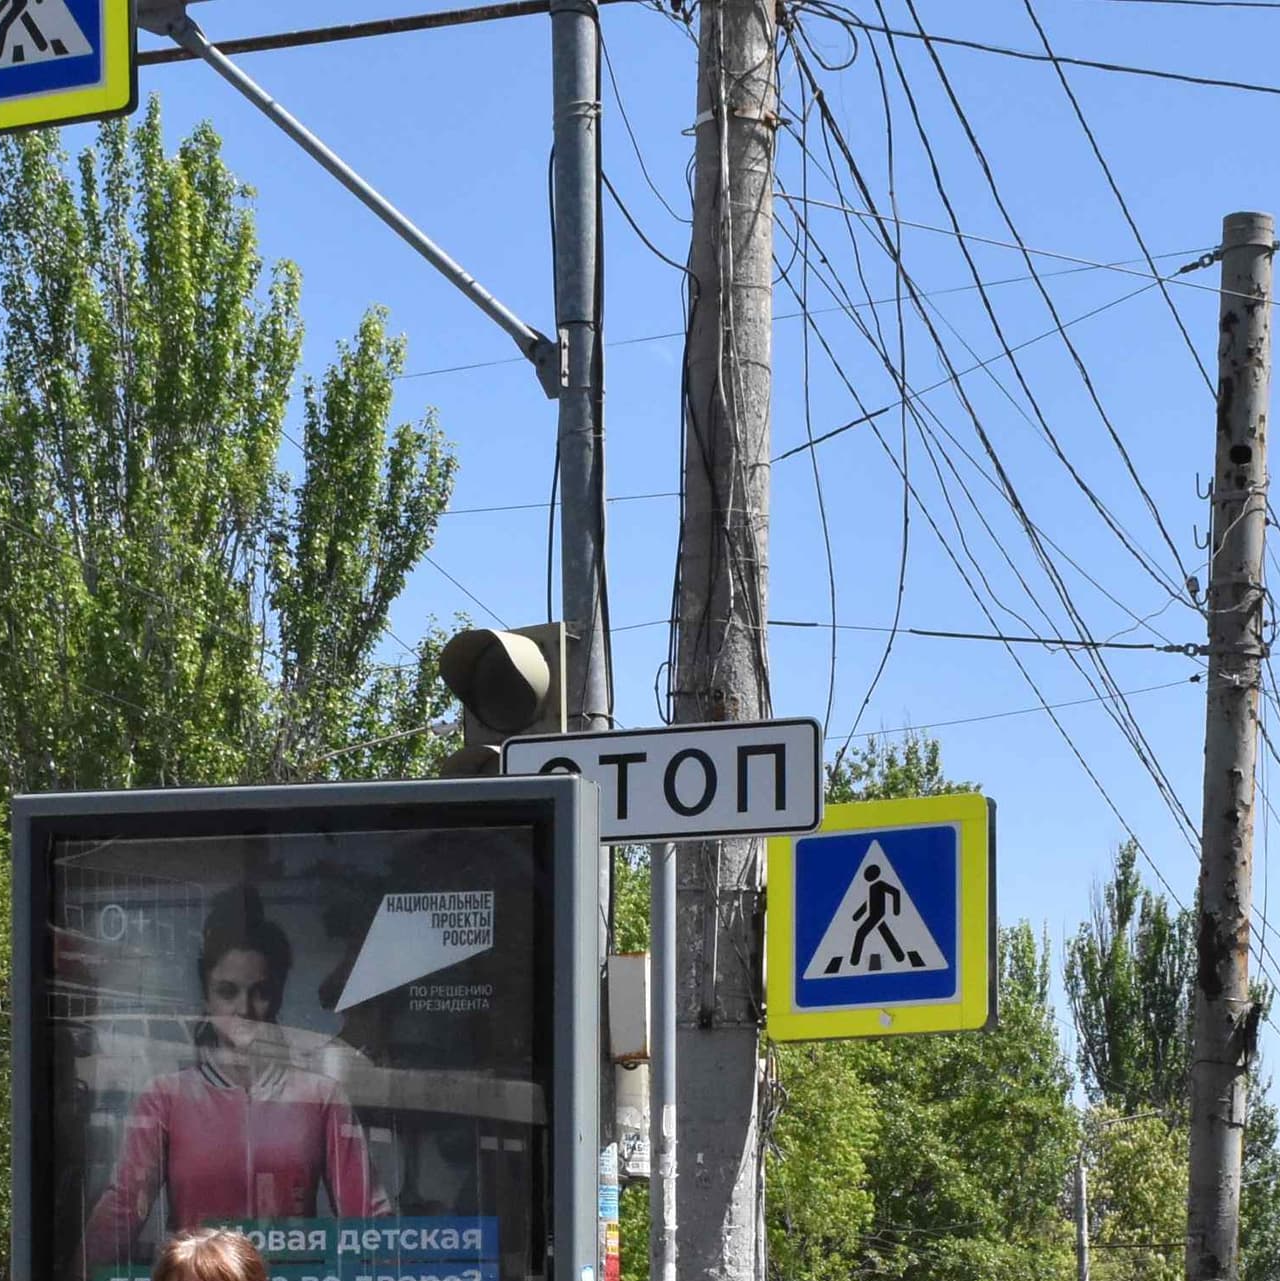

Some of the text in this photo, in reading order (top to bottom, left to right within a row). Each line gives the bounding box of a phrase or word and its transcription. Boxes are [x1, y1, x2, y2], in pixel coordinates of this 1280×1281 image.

[538, 743, 786, 820] ТОП
[386, 893, 492, 914] НАЦИОНАЛЬНЫЕ
[100, 904, 151, 941] 0+
[431, 911, 492, 929] ПРОЕКТЫ
[443, 928, 492, 947] РОССИИ
[409, 984, 493, 997] ПО РЕШЕНИЮ
[409, 998, 490, 1013] ПРЕЗИДЕНТА
[221, 1226, 483, 1254] овая детская
